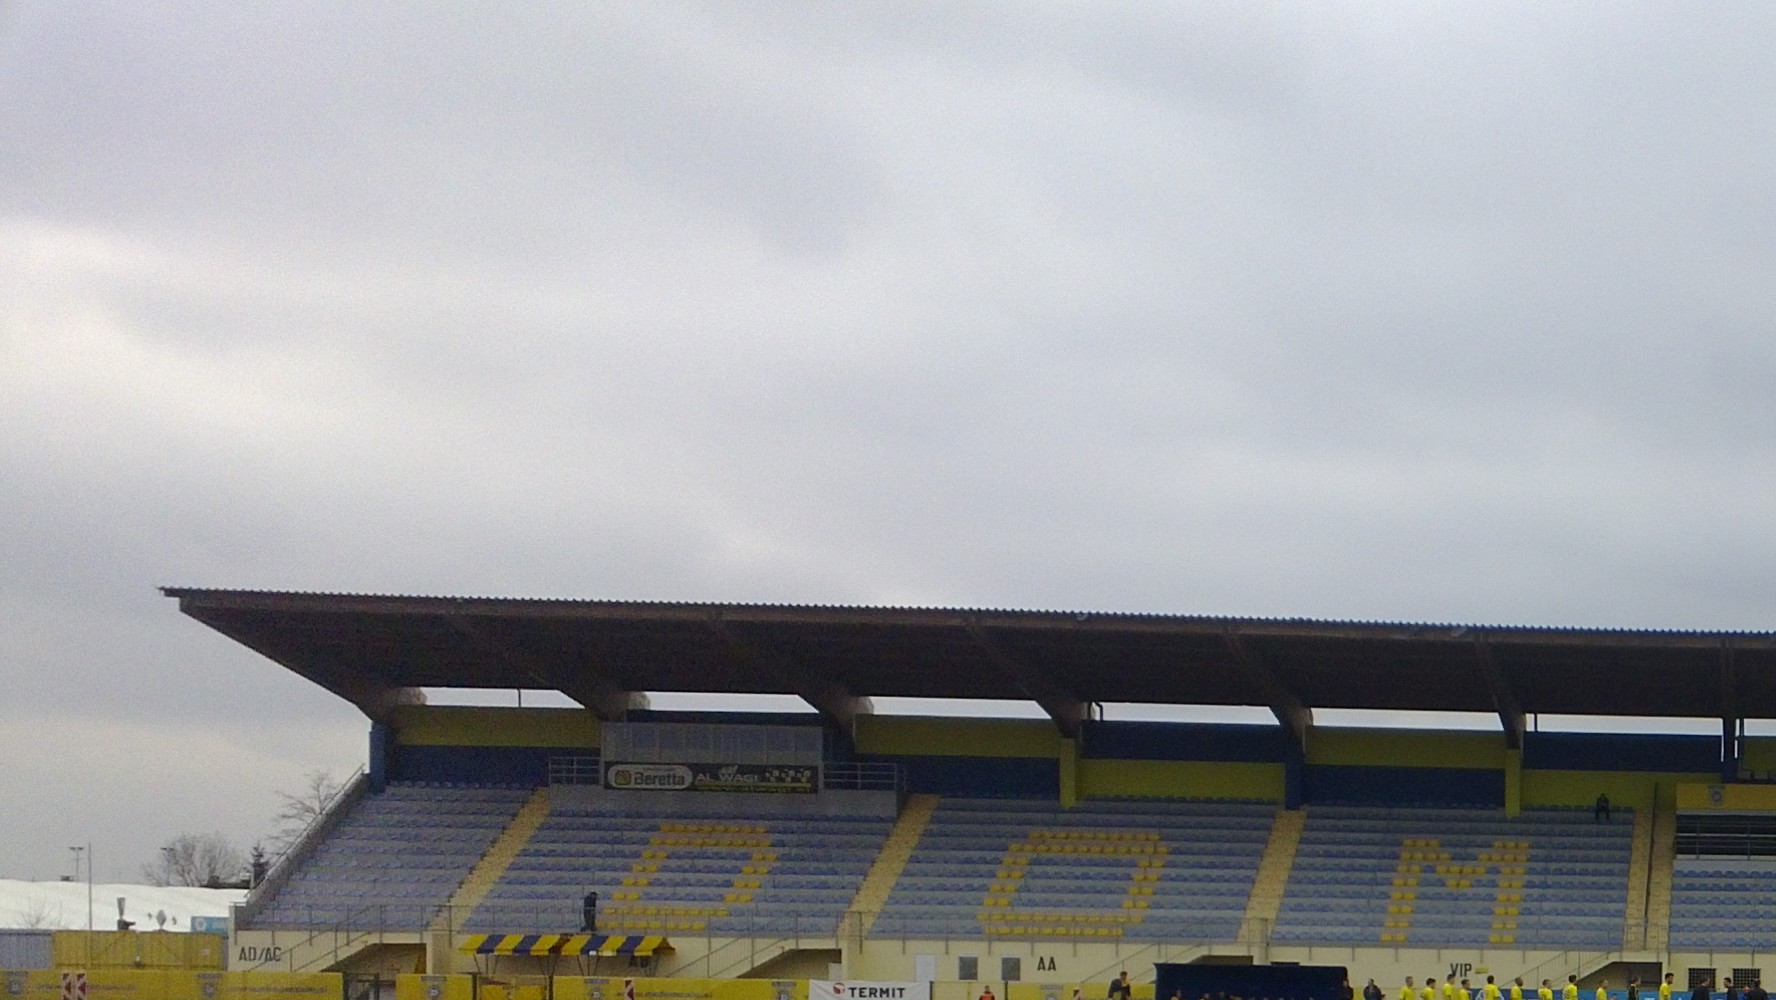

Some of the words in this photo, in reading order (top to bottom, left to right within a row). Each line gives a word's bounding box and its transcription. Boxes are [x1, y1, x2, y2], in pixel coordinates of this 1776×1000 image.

[634, 771, 686, 785] Beretta
[238, 946, 282, 962] AD/AC
[1037, 956, 1057, 971] AA
[1449, 963, 1473, 978] VIP
[848, 987, 906, 999] TERMIT
